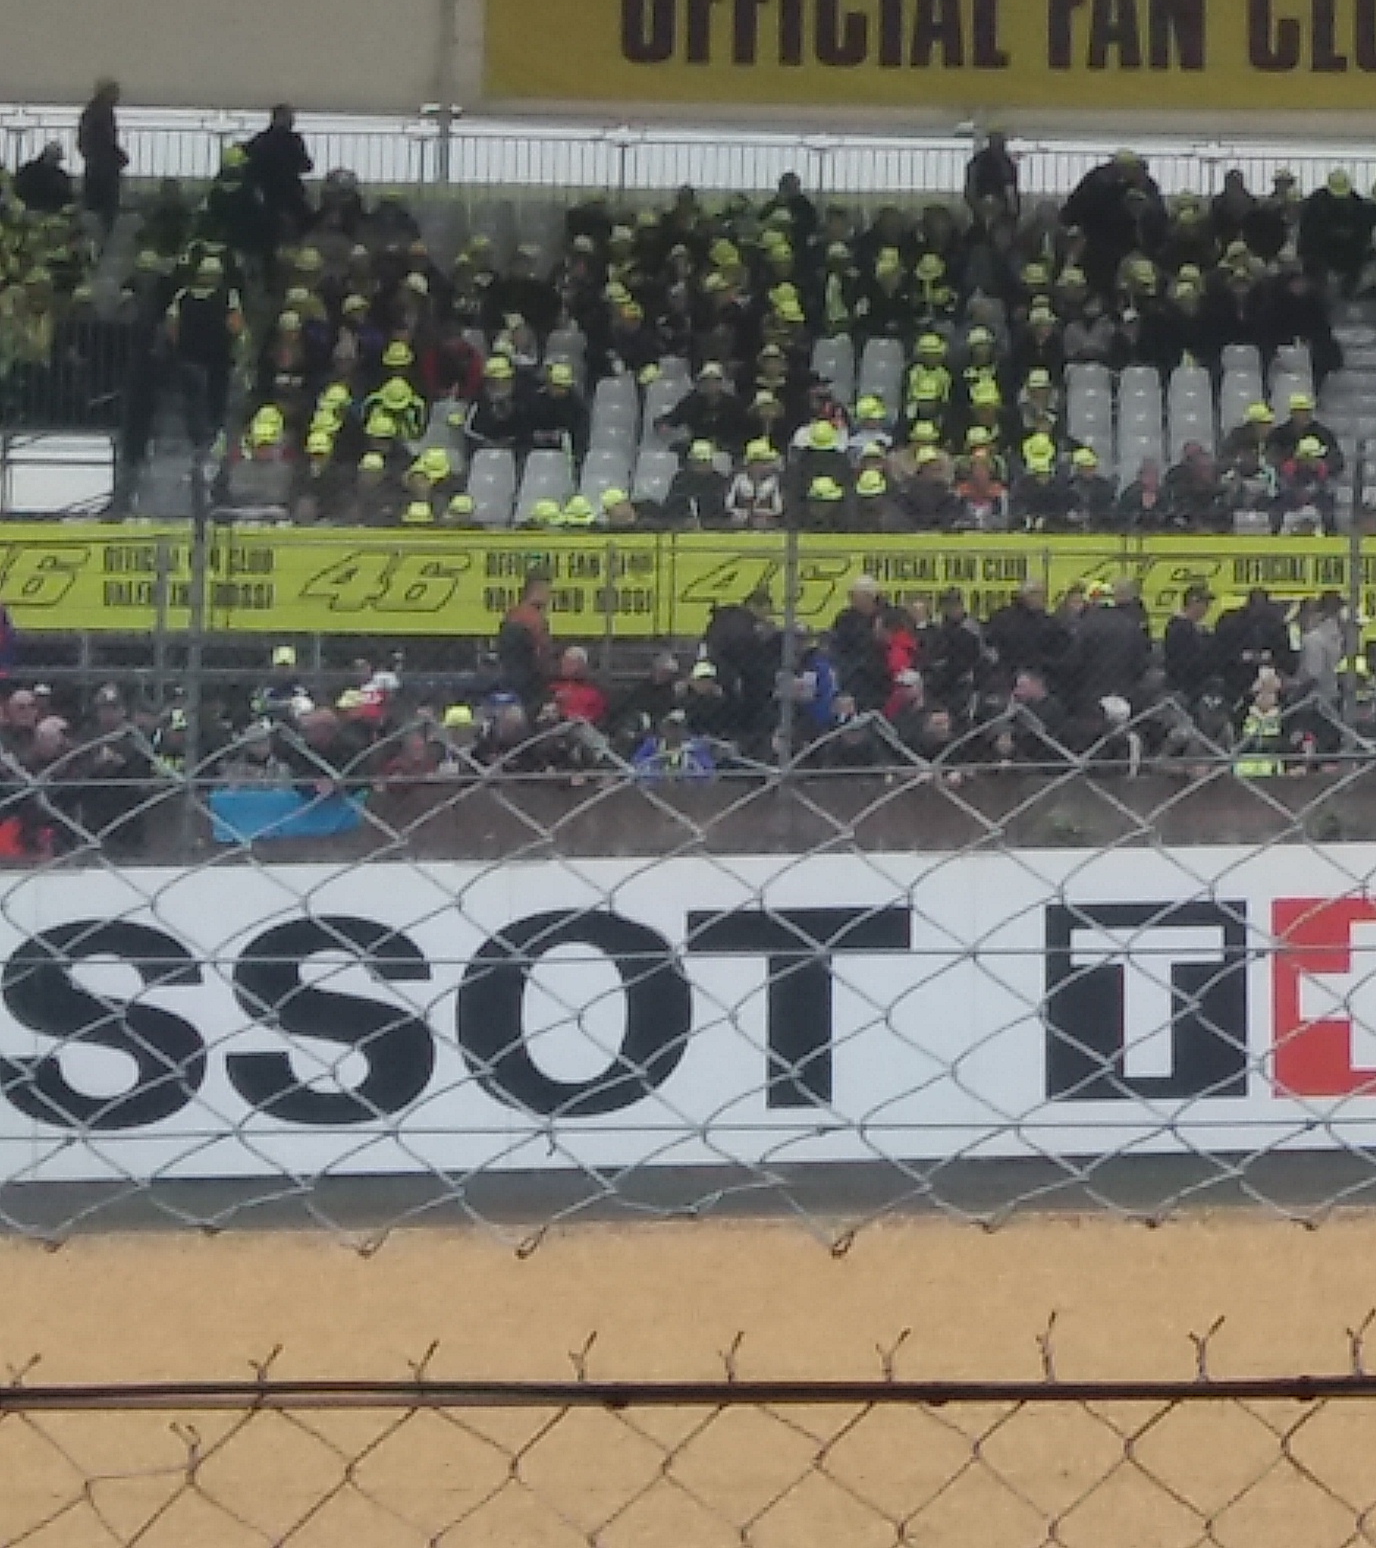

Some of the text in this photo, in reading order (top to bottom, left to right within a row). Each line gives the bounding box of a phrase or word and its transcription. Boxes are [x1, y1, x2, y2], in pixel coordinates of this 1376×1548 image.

[0, 544, 91, 606] 6
[103, 545, 179, 573] OFFICIL
[299, 550, 471, 612] 46
[945, 555, 978, 582] FAN
[982, 556, 1027, 582] CLUB
[1233, 556, 1306, 584] OFFICIAL
[1314, 556, 1345, 584] FAN
[0, 906, 911, 1131] SSOT
